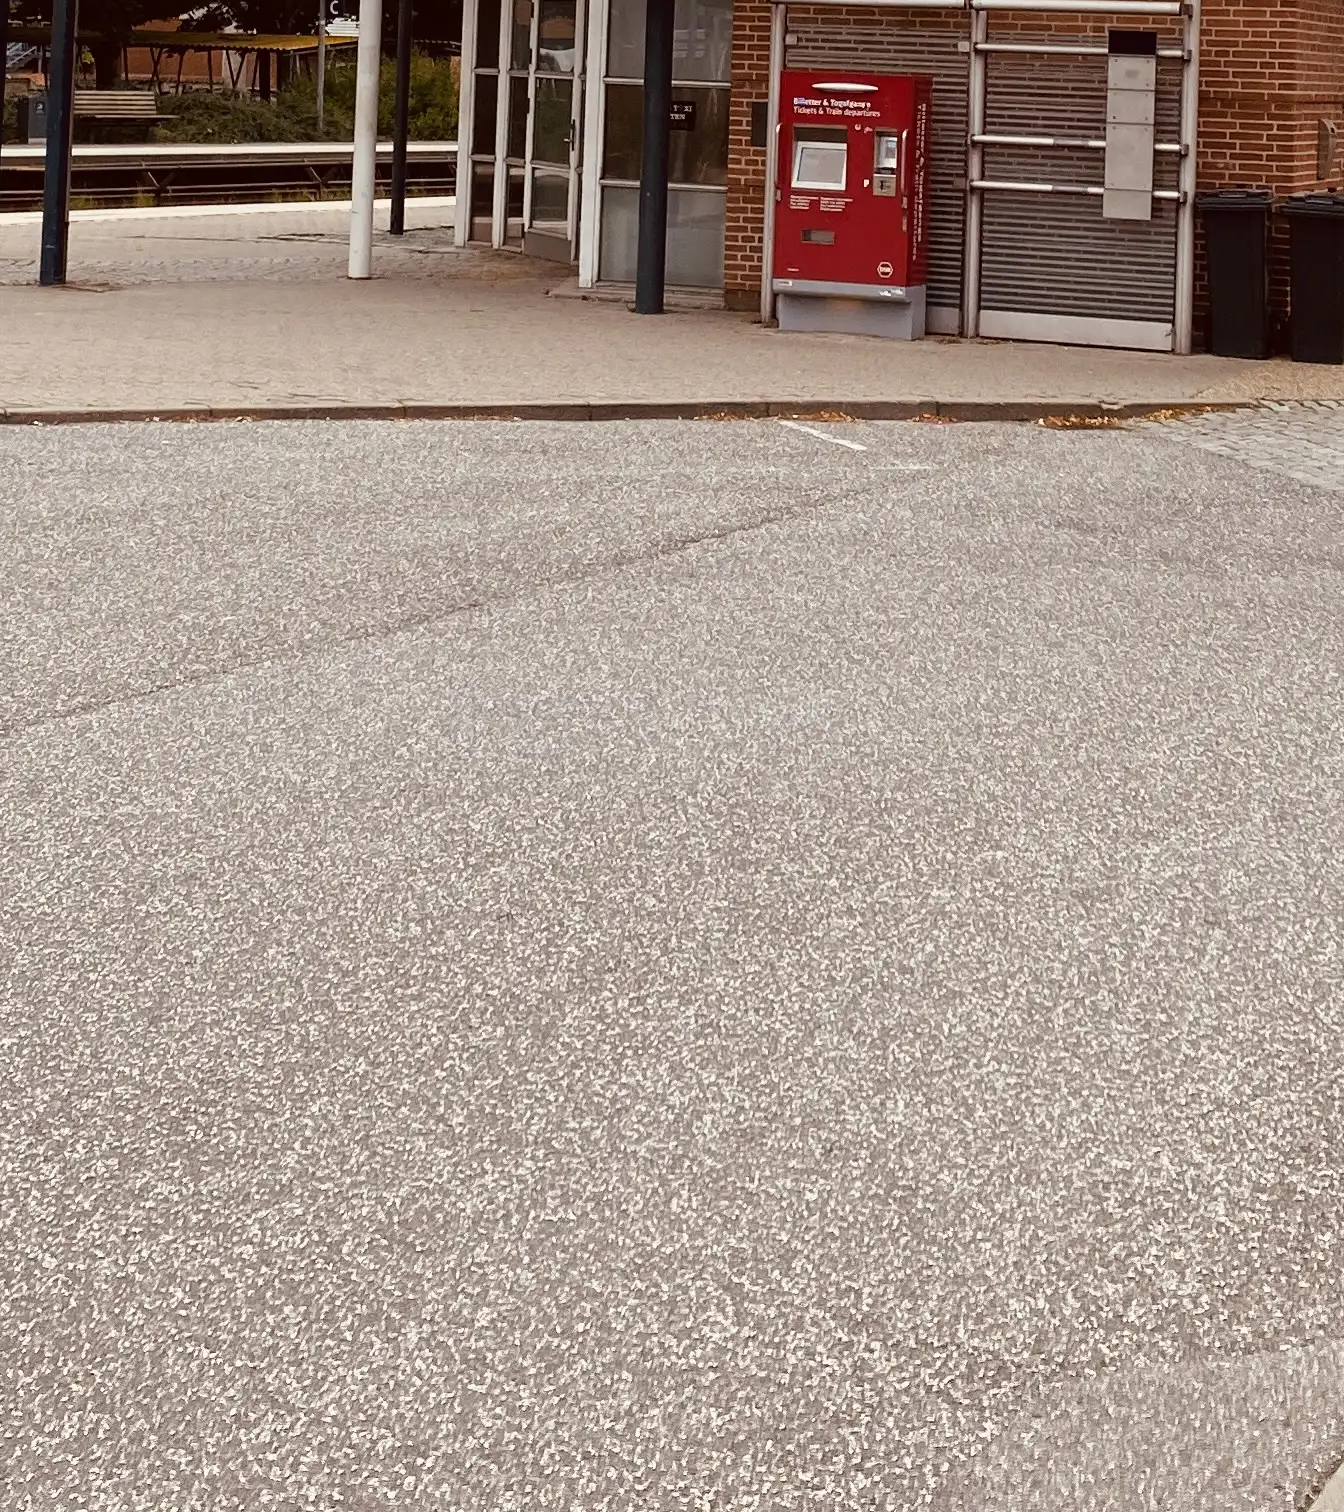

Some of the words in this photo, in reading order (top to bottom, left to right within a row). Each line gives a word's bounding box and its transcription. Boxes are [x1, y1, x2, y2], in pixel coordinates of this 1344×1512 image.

[330, 0, 339, 15] C
[793, 106, 817, 115] Tickets
[826, 107, 843, 116] Train
